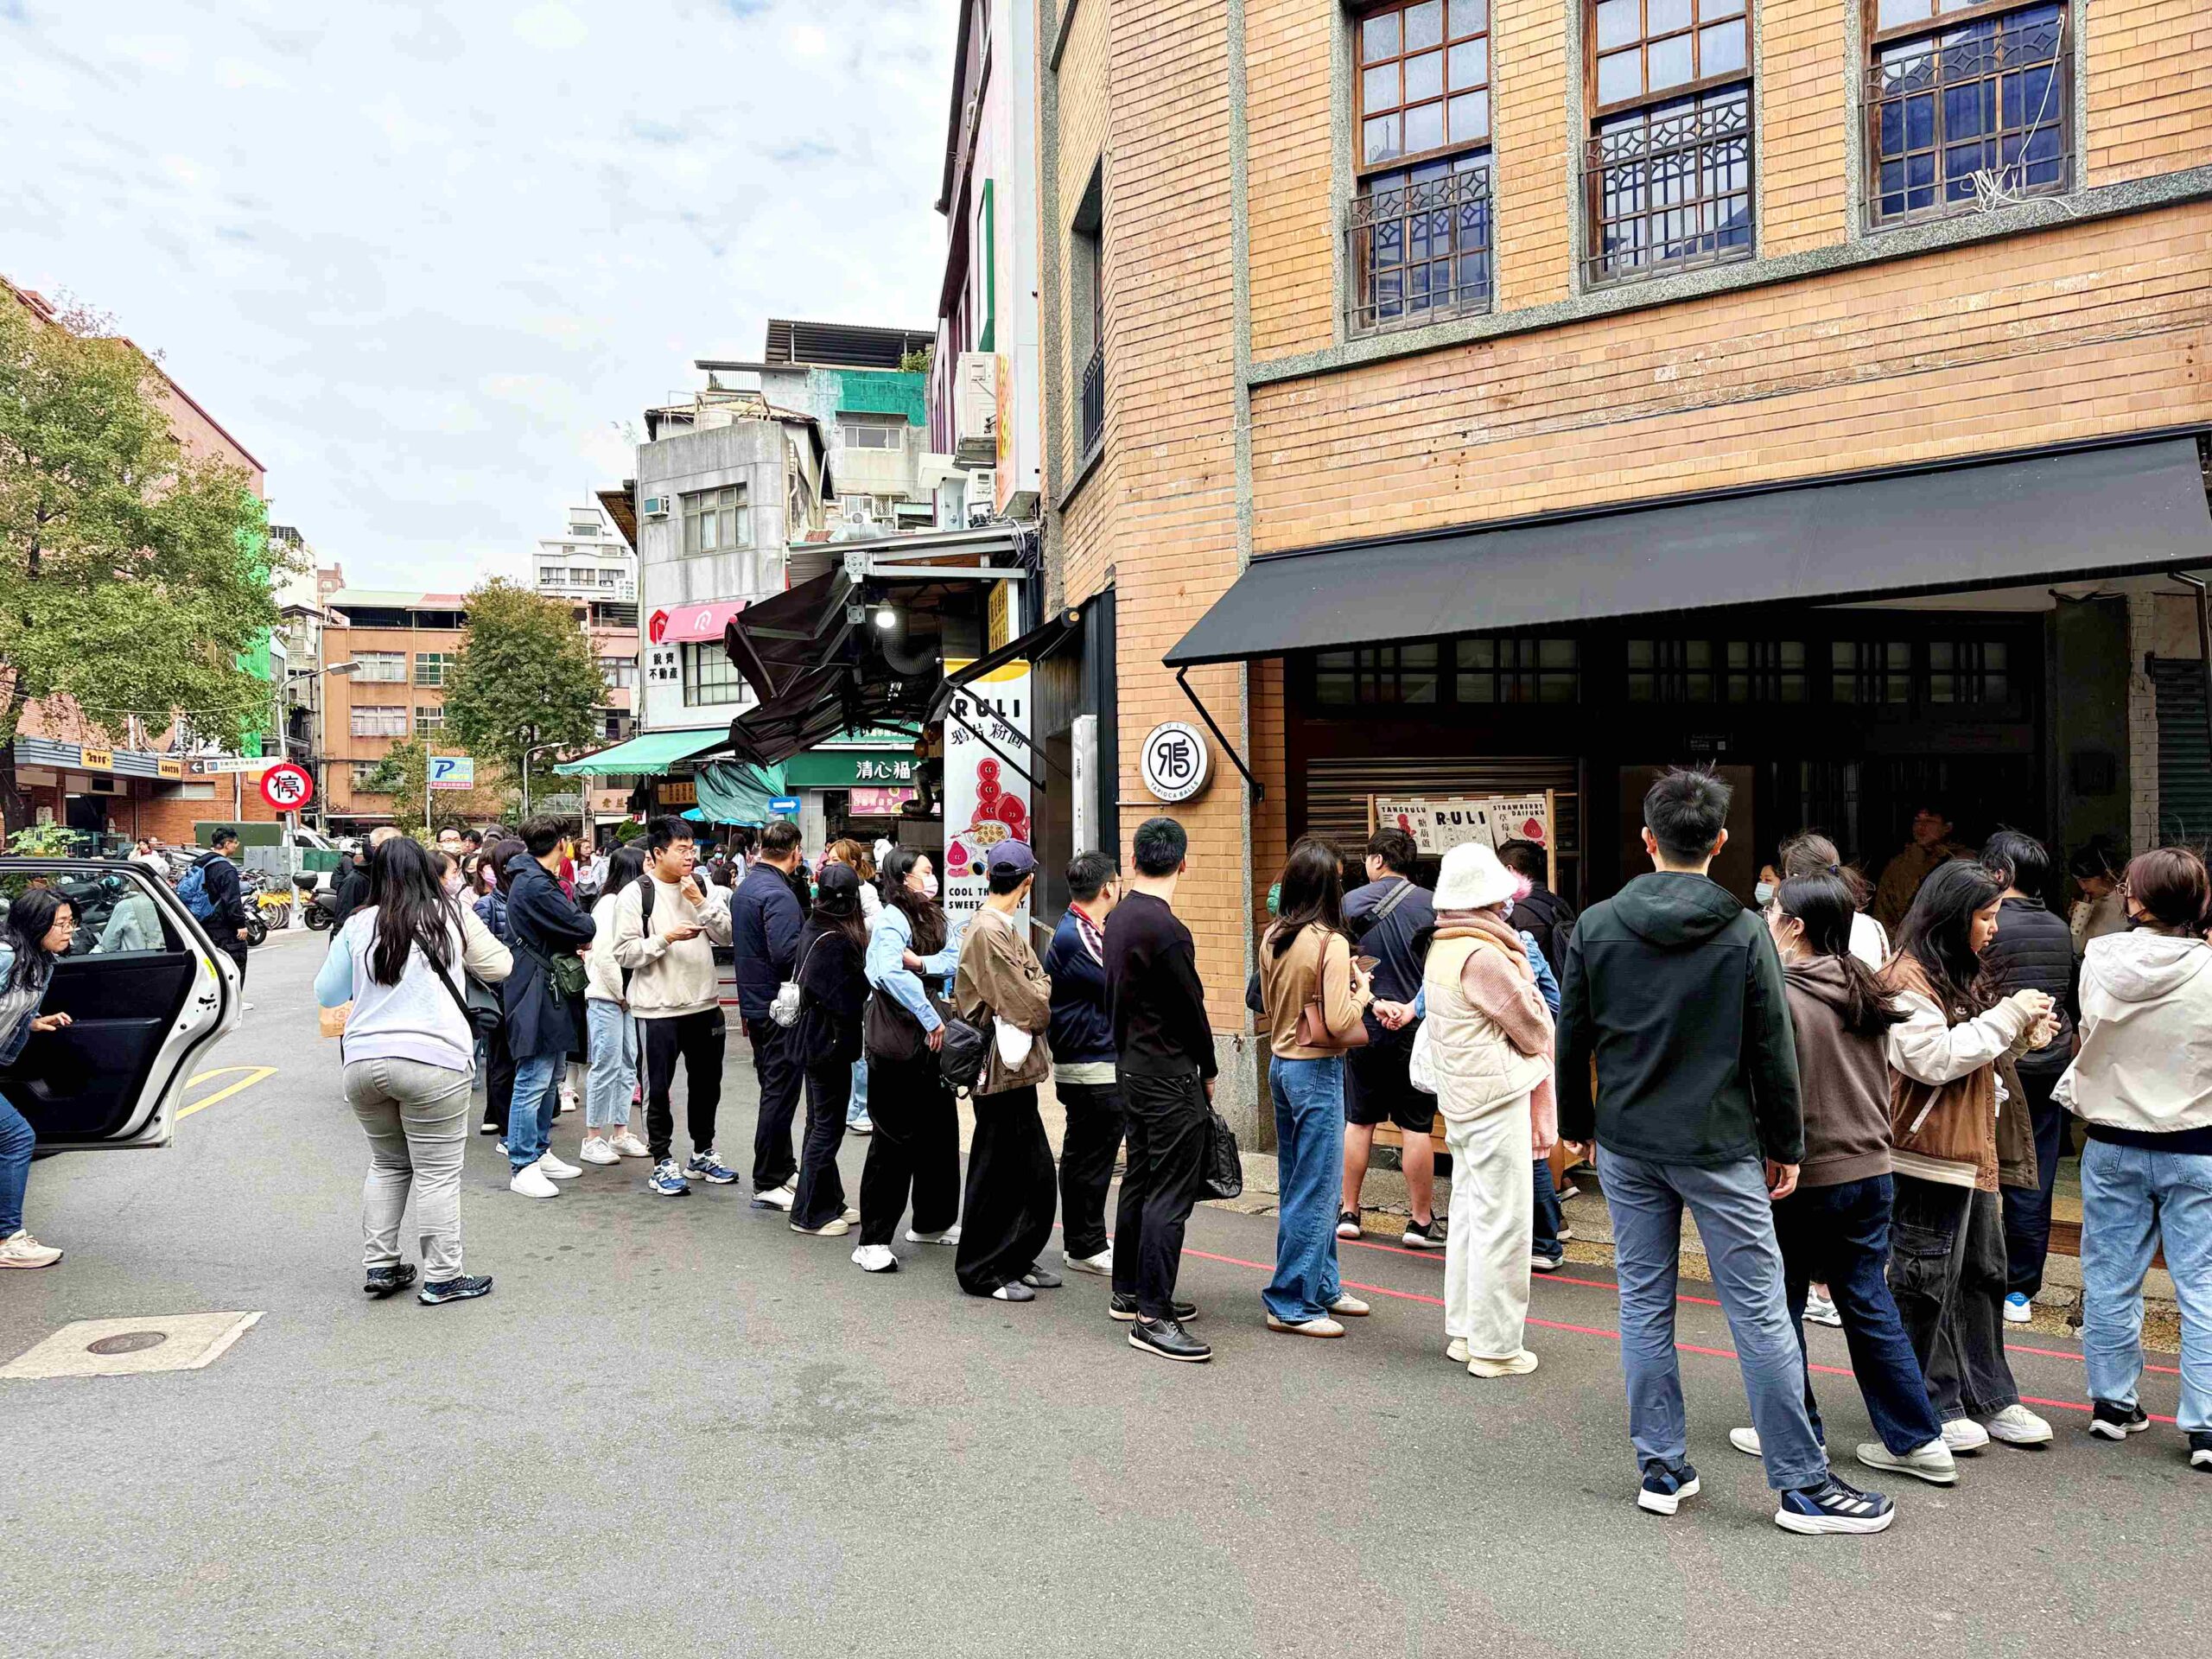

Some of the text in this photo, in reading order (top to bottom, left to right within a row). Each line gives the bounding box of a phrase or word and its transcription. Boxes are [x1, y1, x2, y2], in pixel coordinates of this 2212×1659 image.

[649, 667, 678, 680] 不動產
[955, 698, 1020, 718] RULI
[1159, 724, 1189, 733] RULI
[435, 760, 455, 779] P
[273, 775, 300, 799] 停
[1150, 780, 1198, 798] TAPIOCA BALLS
[1436, 811, 1485, 825] RULI
[949, 887, 974, 896] COOL
